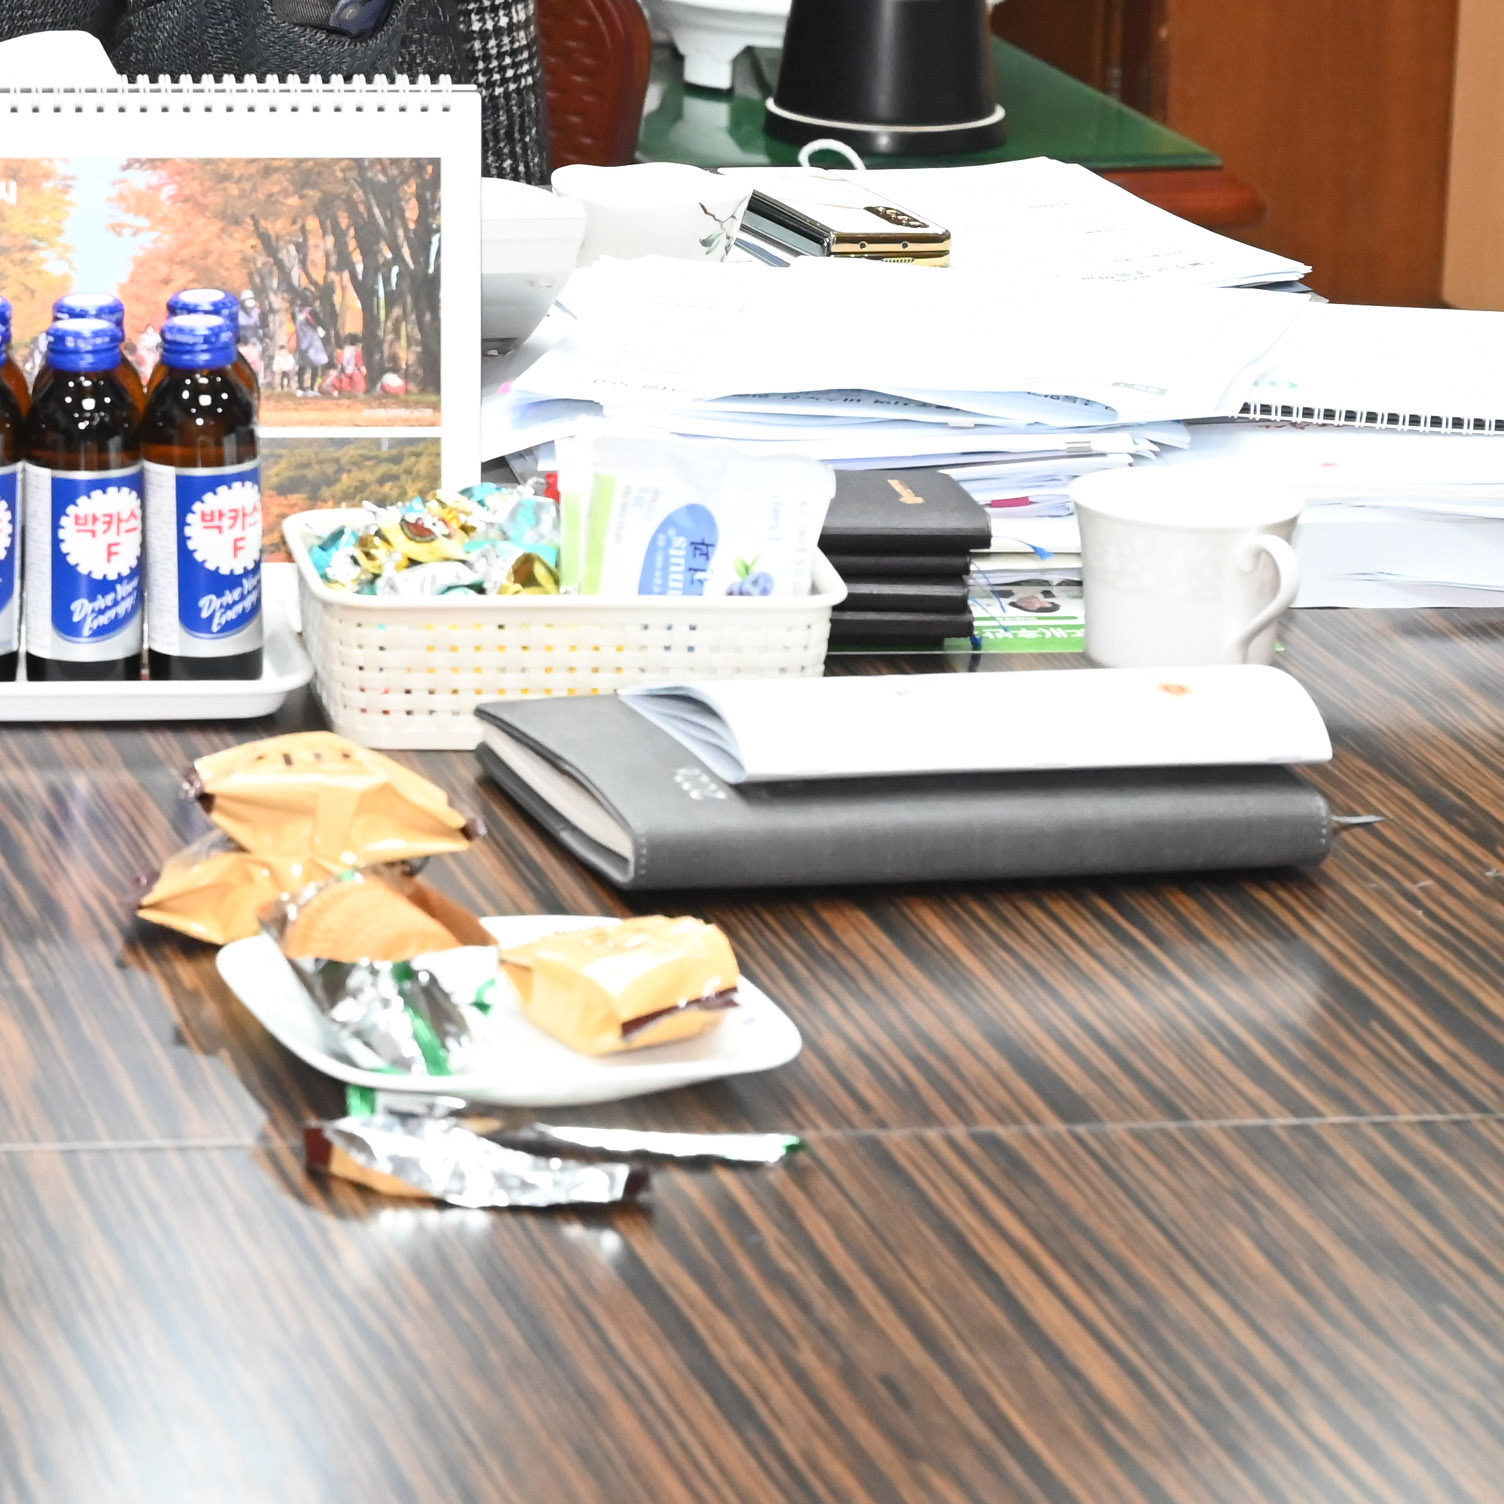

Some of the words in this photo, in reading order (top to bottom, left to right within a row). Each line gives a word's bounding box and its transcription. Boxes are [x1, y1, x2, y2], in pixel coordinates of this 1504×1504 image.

[74, 511, 139, 538] 박카스
[107, 542, 121, 564] F
[233, 537, 246, 559] F
[70, 592, 116, 623] Drive
[198, 589, 242, 619] Drive
